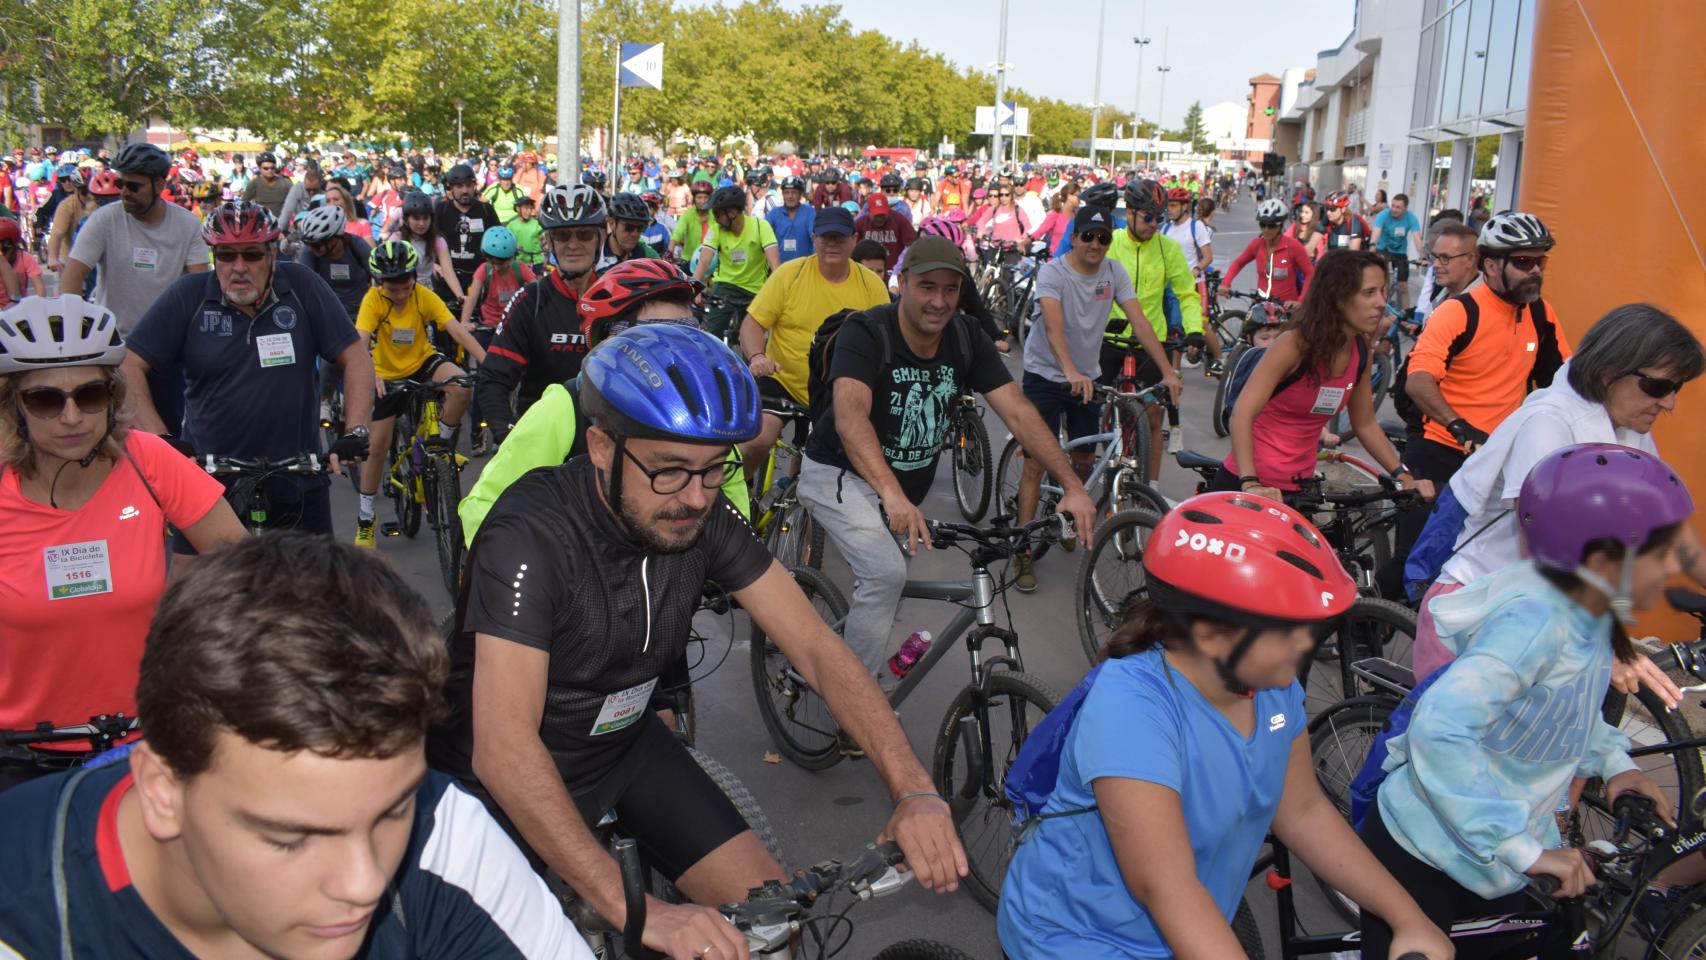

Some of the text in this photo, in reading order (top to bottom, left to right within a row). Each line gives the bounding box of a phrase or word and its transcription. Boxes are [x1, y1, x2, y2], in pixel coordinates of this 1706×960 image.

[908, 450, 921, 461] DE
[89, 545, 101, 553] de
[69, 552, 104, 563] Bicicleta
[66, 571, 92, 580] 1516
